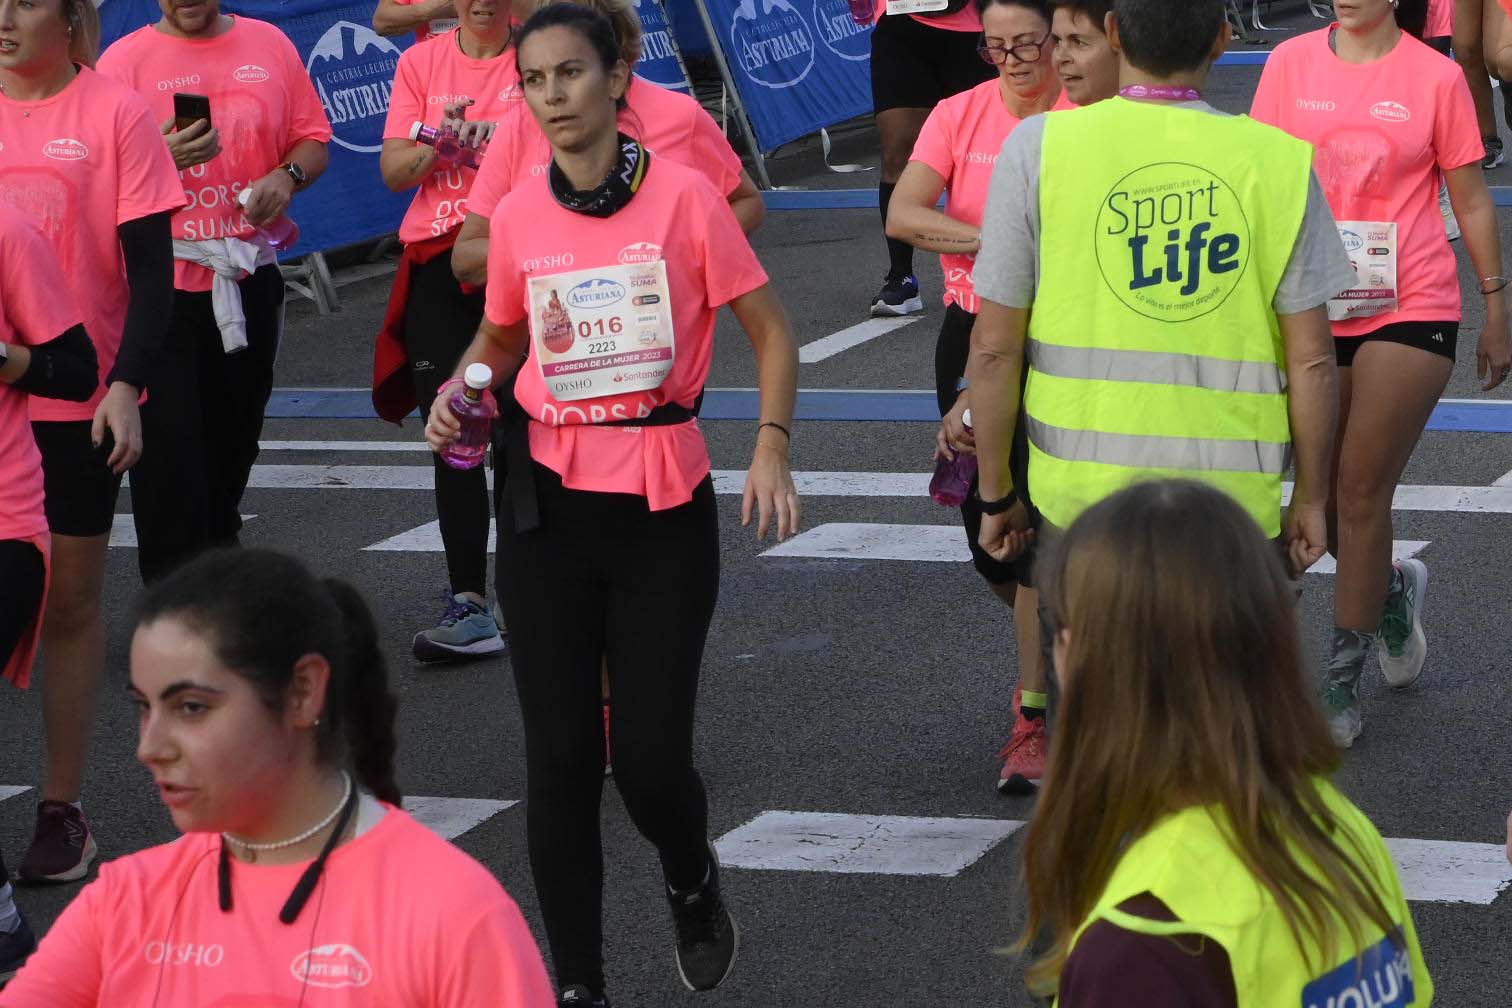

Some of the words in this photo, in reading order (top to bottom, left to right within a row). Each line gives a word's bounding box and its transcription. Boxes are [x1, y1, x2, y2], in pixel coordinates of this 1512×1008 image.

[158, 75, 200, 91] OYSHO
[1108, 180, 1219, 239] Sport
[183, 215, 255, 241] SUMA
[524, 253, 574, 273] OYSHO
[1128, 222, 1240, 296] Life
[571, 289, 622, 304] ASTURIANA
[578, 316, 623, 338] 016
[588, 342, 617, 354] 2223
[555, 362, 588, 373] CARRERA
[590, 360, 601, 368] DE
[602, 358, 612, 367] LA
[613, 354, 640, 365] MUJER
[642, 351, 661, 360] 2023
[555, 378, 592, 393] OYSHO
[624, 369, 666, 383] Santander
